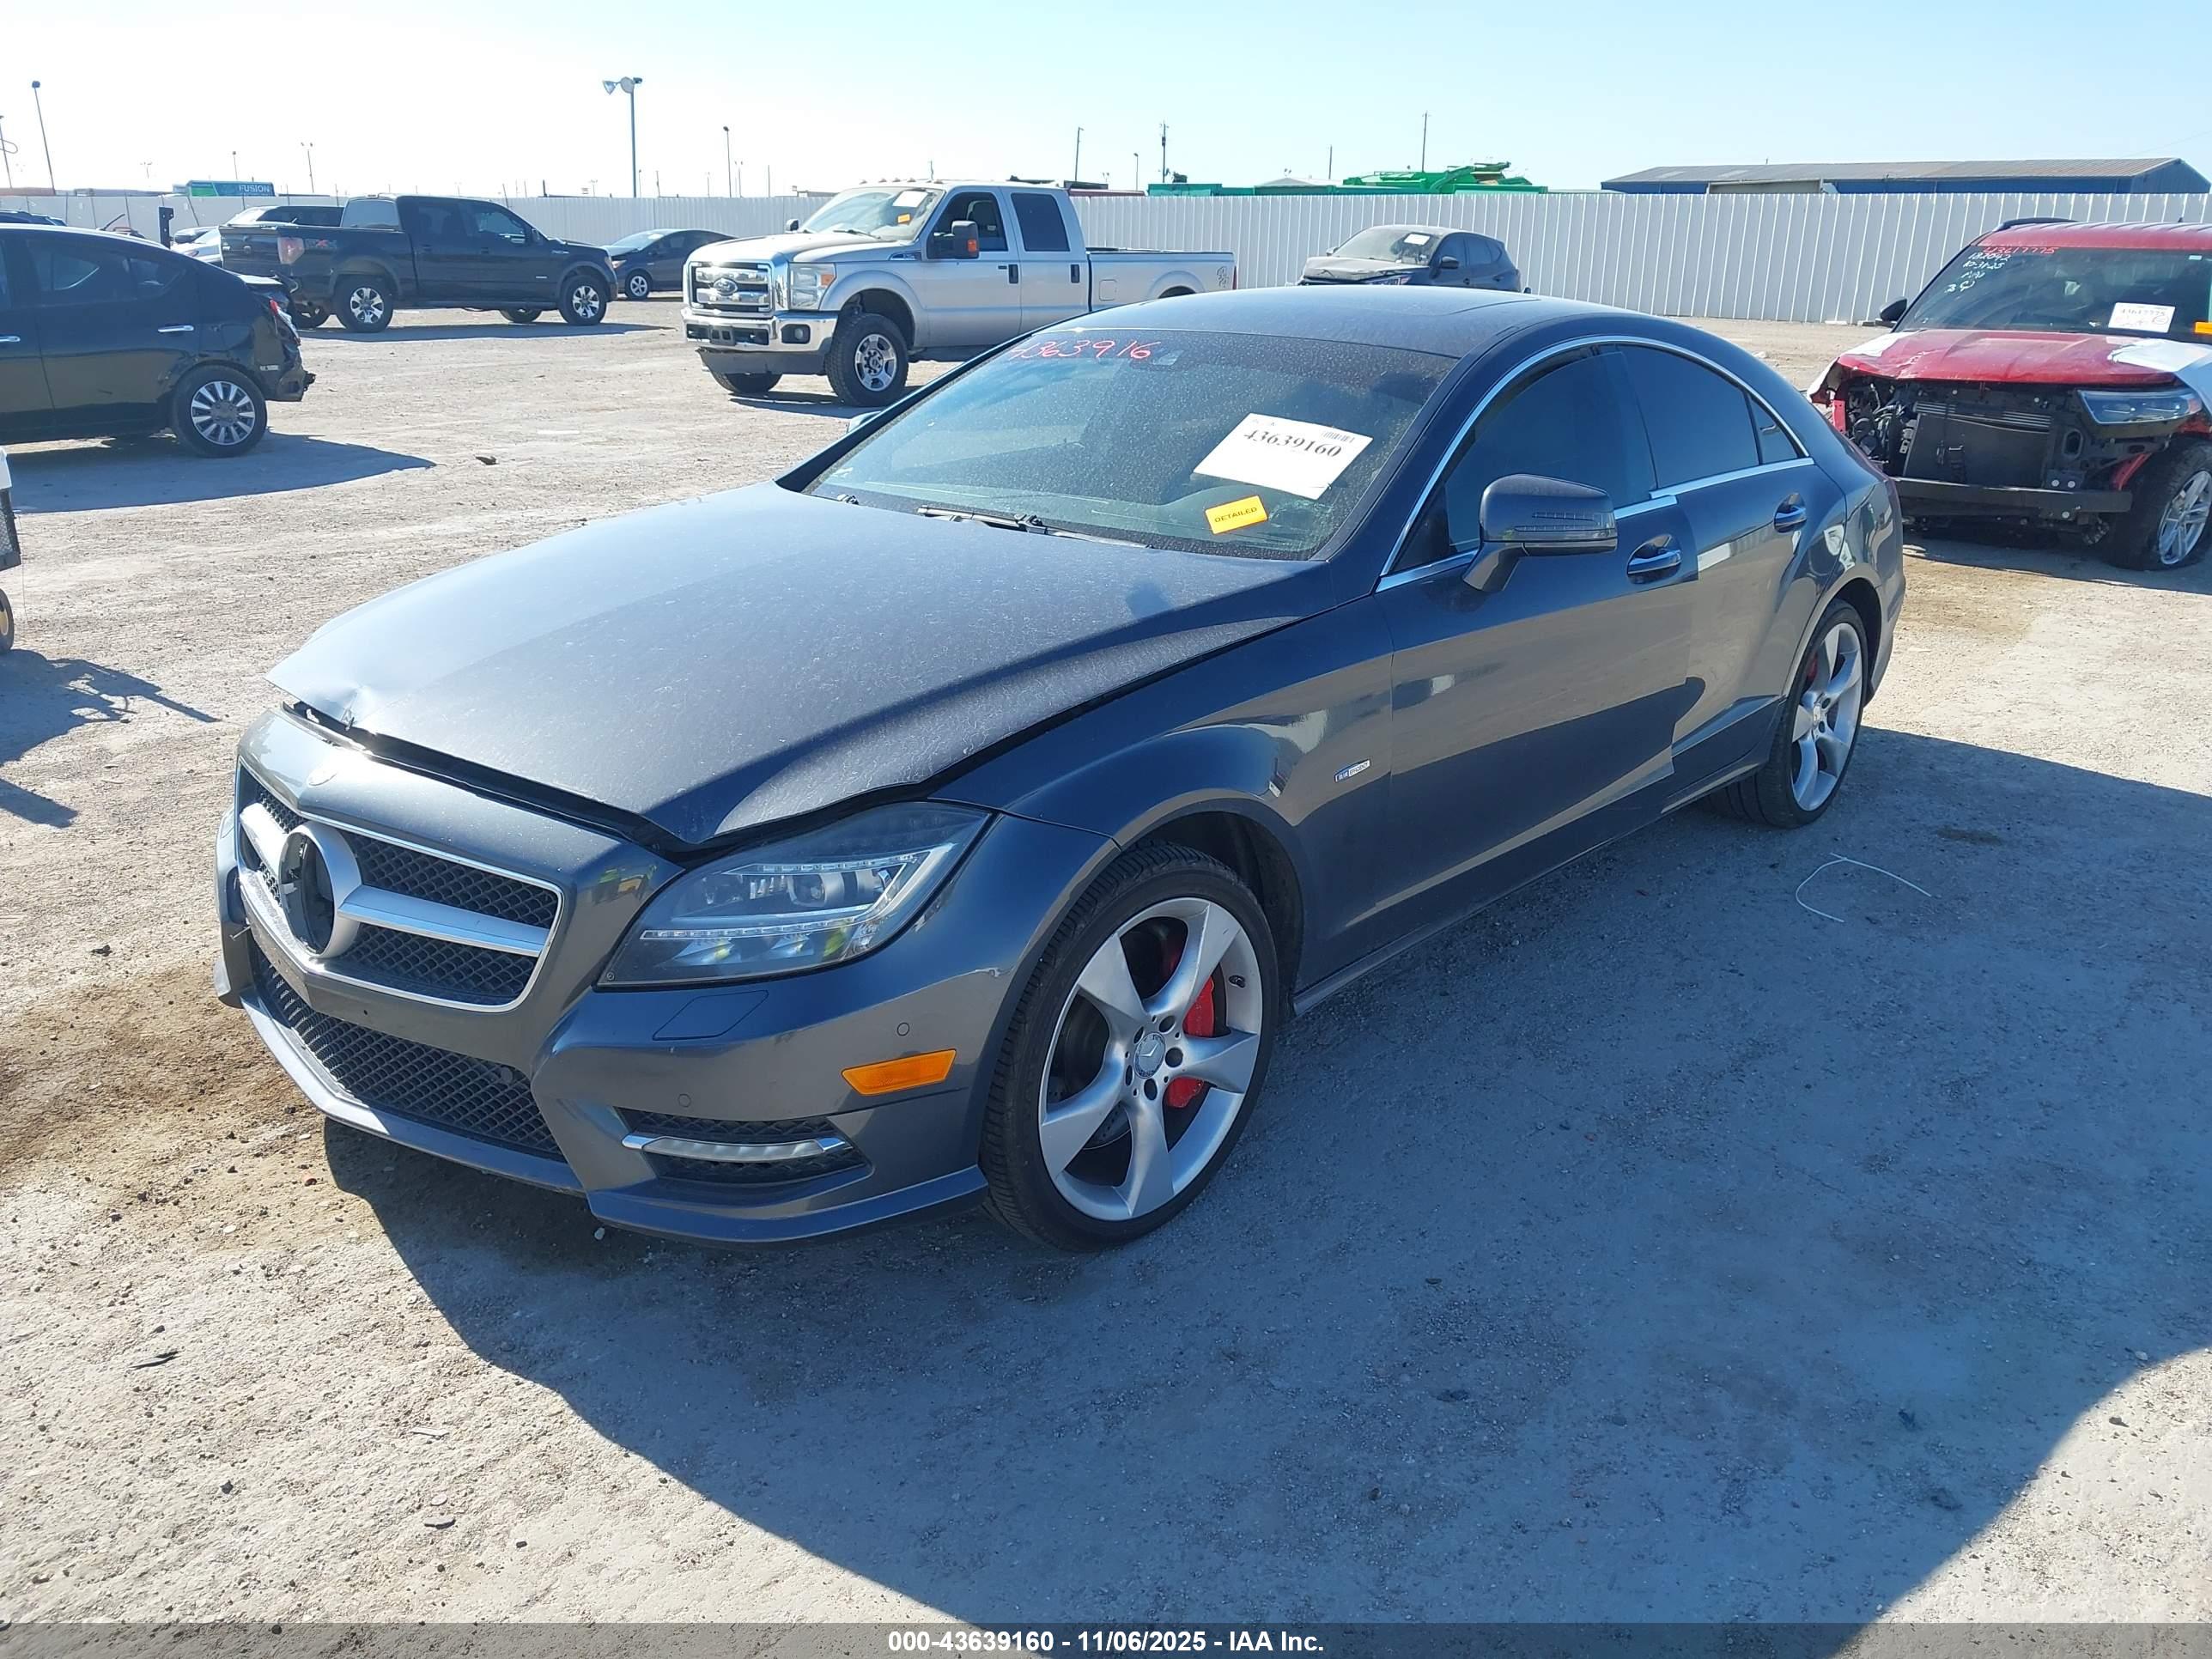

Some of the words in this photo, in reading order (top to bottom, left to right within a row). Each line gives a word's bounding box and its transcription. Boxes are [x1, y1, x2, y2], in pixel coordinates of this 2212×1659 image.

[239, 184, 270, 193] FUSION
[1243, 429, 1342, 458] 43639160
[1214, 507, 1258, 523] DETAILED
